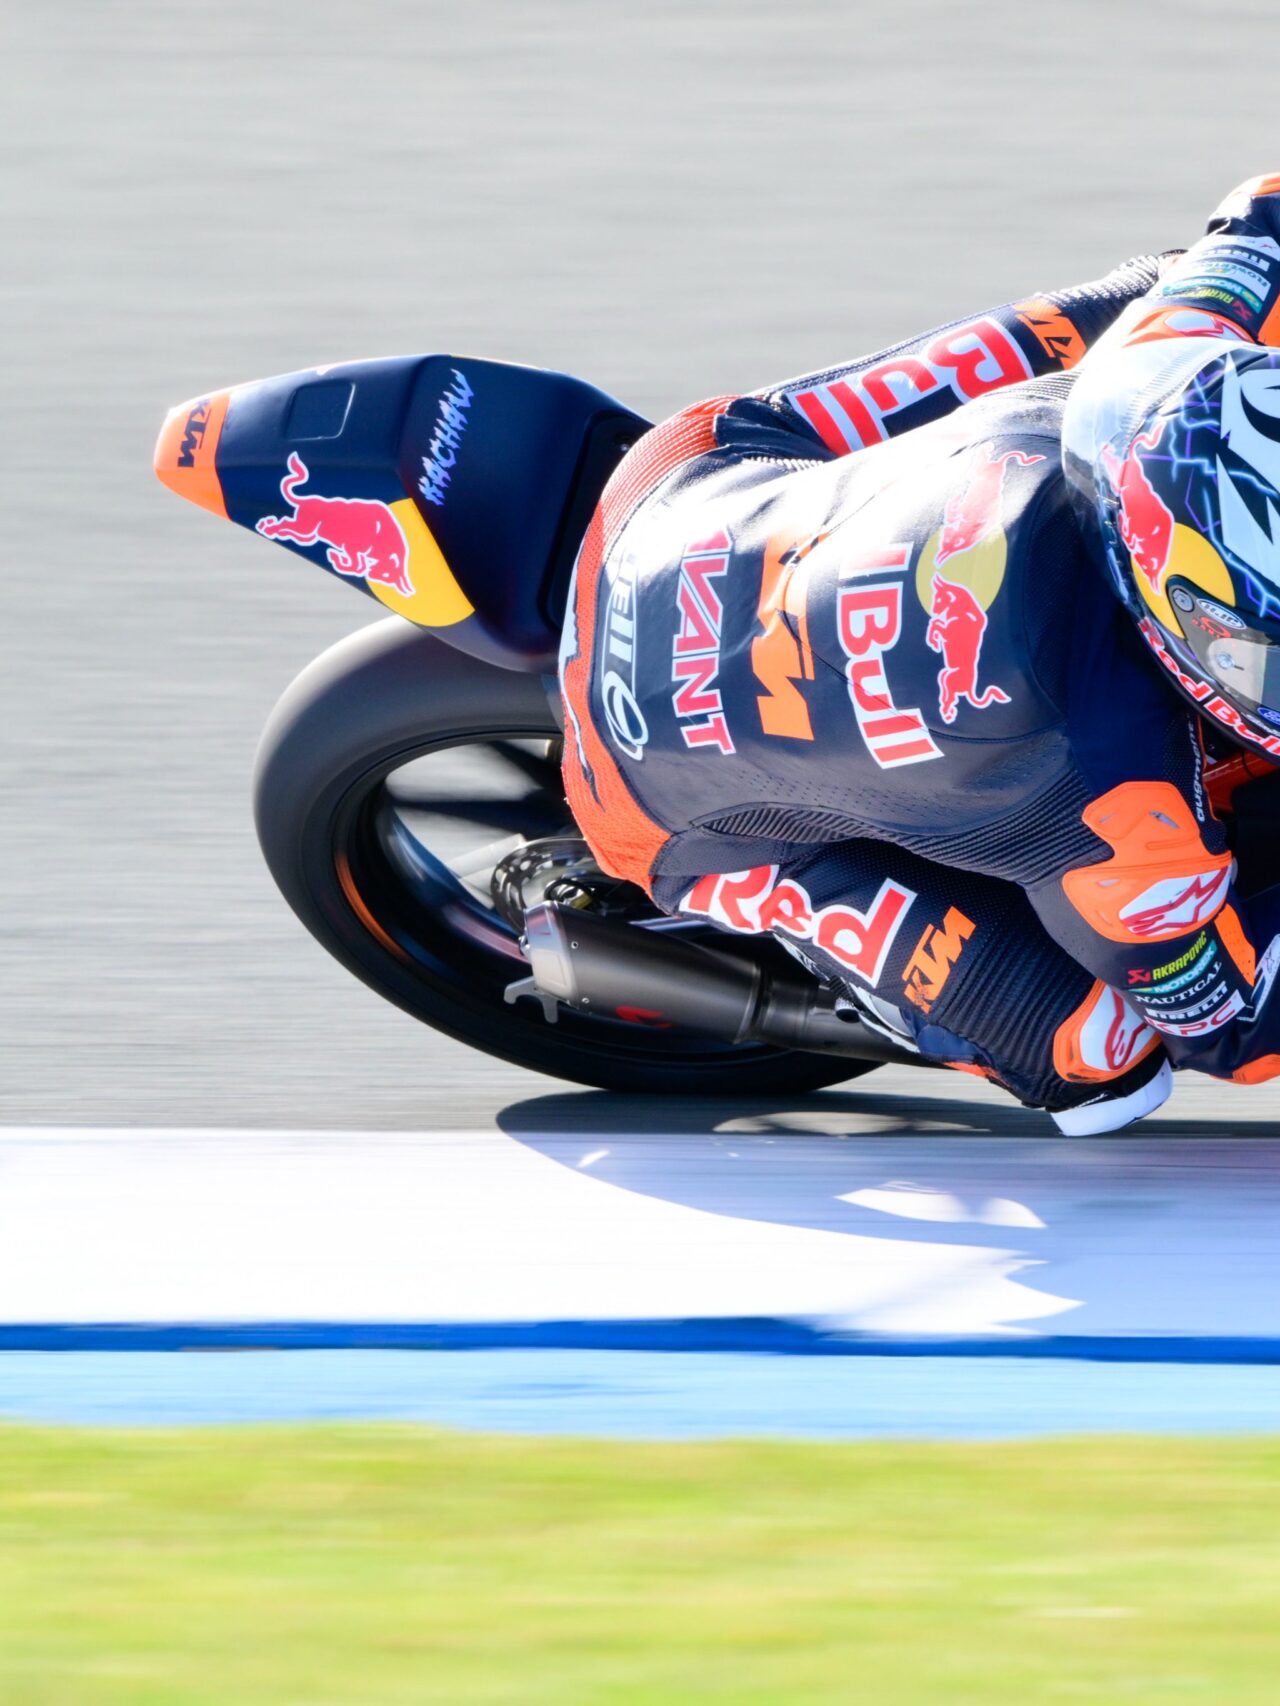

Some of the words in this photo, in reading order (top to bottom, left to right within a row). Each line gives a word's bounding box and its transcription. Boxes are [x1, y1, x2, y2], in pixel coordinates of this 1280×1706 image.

[418, 368, 475, 506] KACHAW
[836, 581, 945, 769] Bull
[678, 864, 918, 989] Red
[901, 906, 976, 1014] KTM
[1134, 961, 1222, 1005] NAUTICAL
